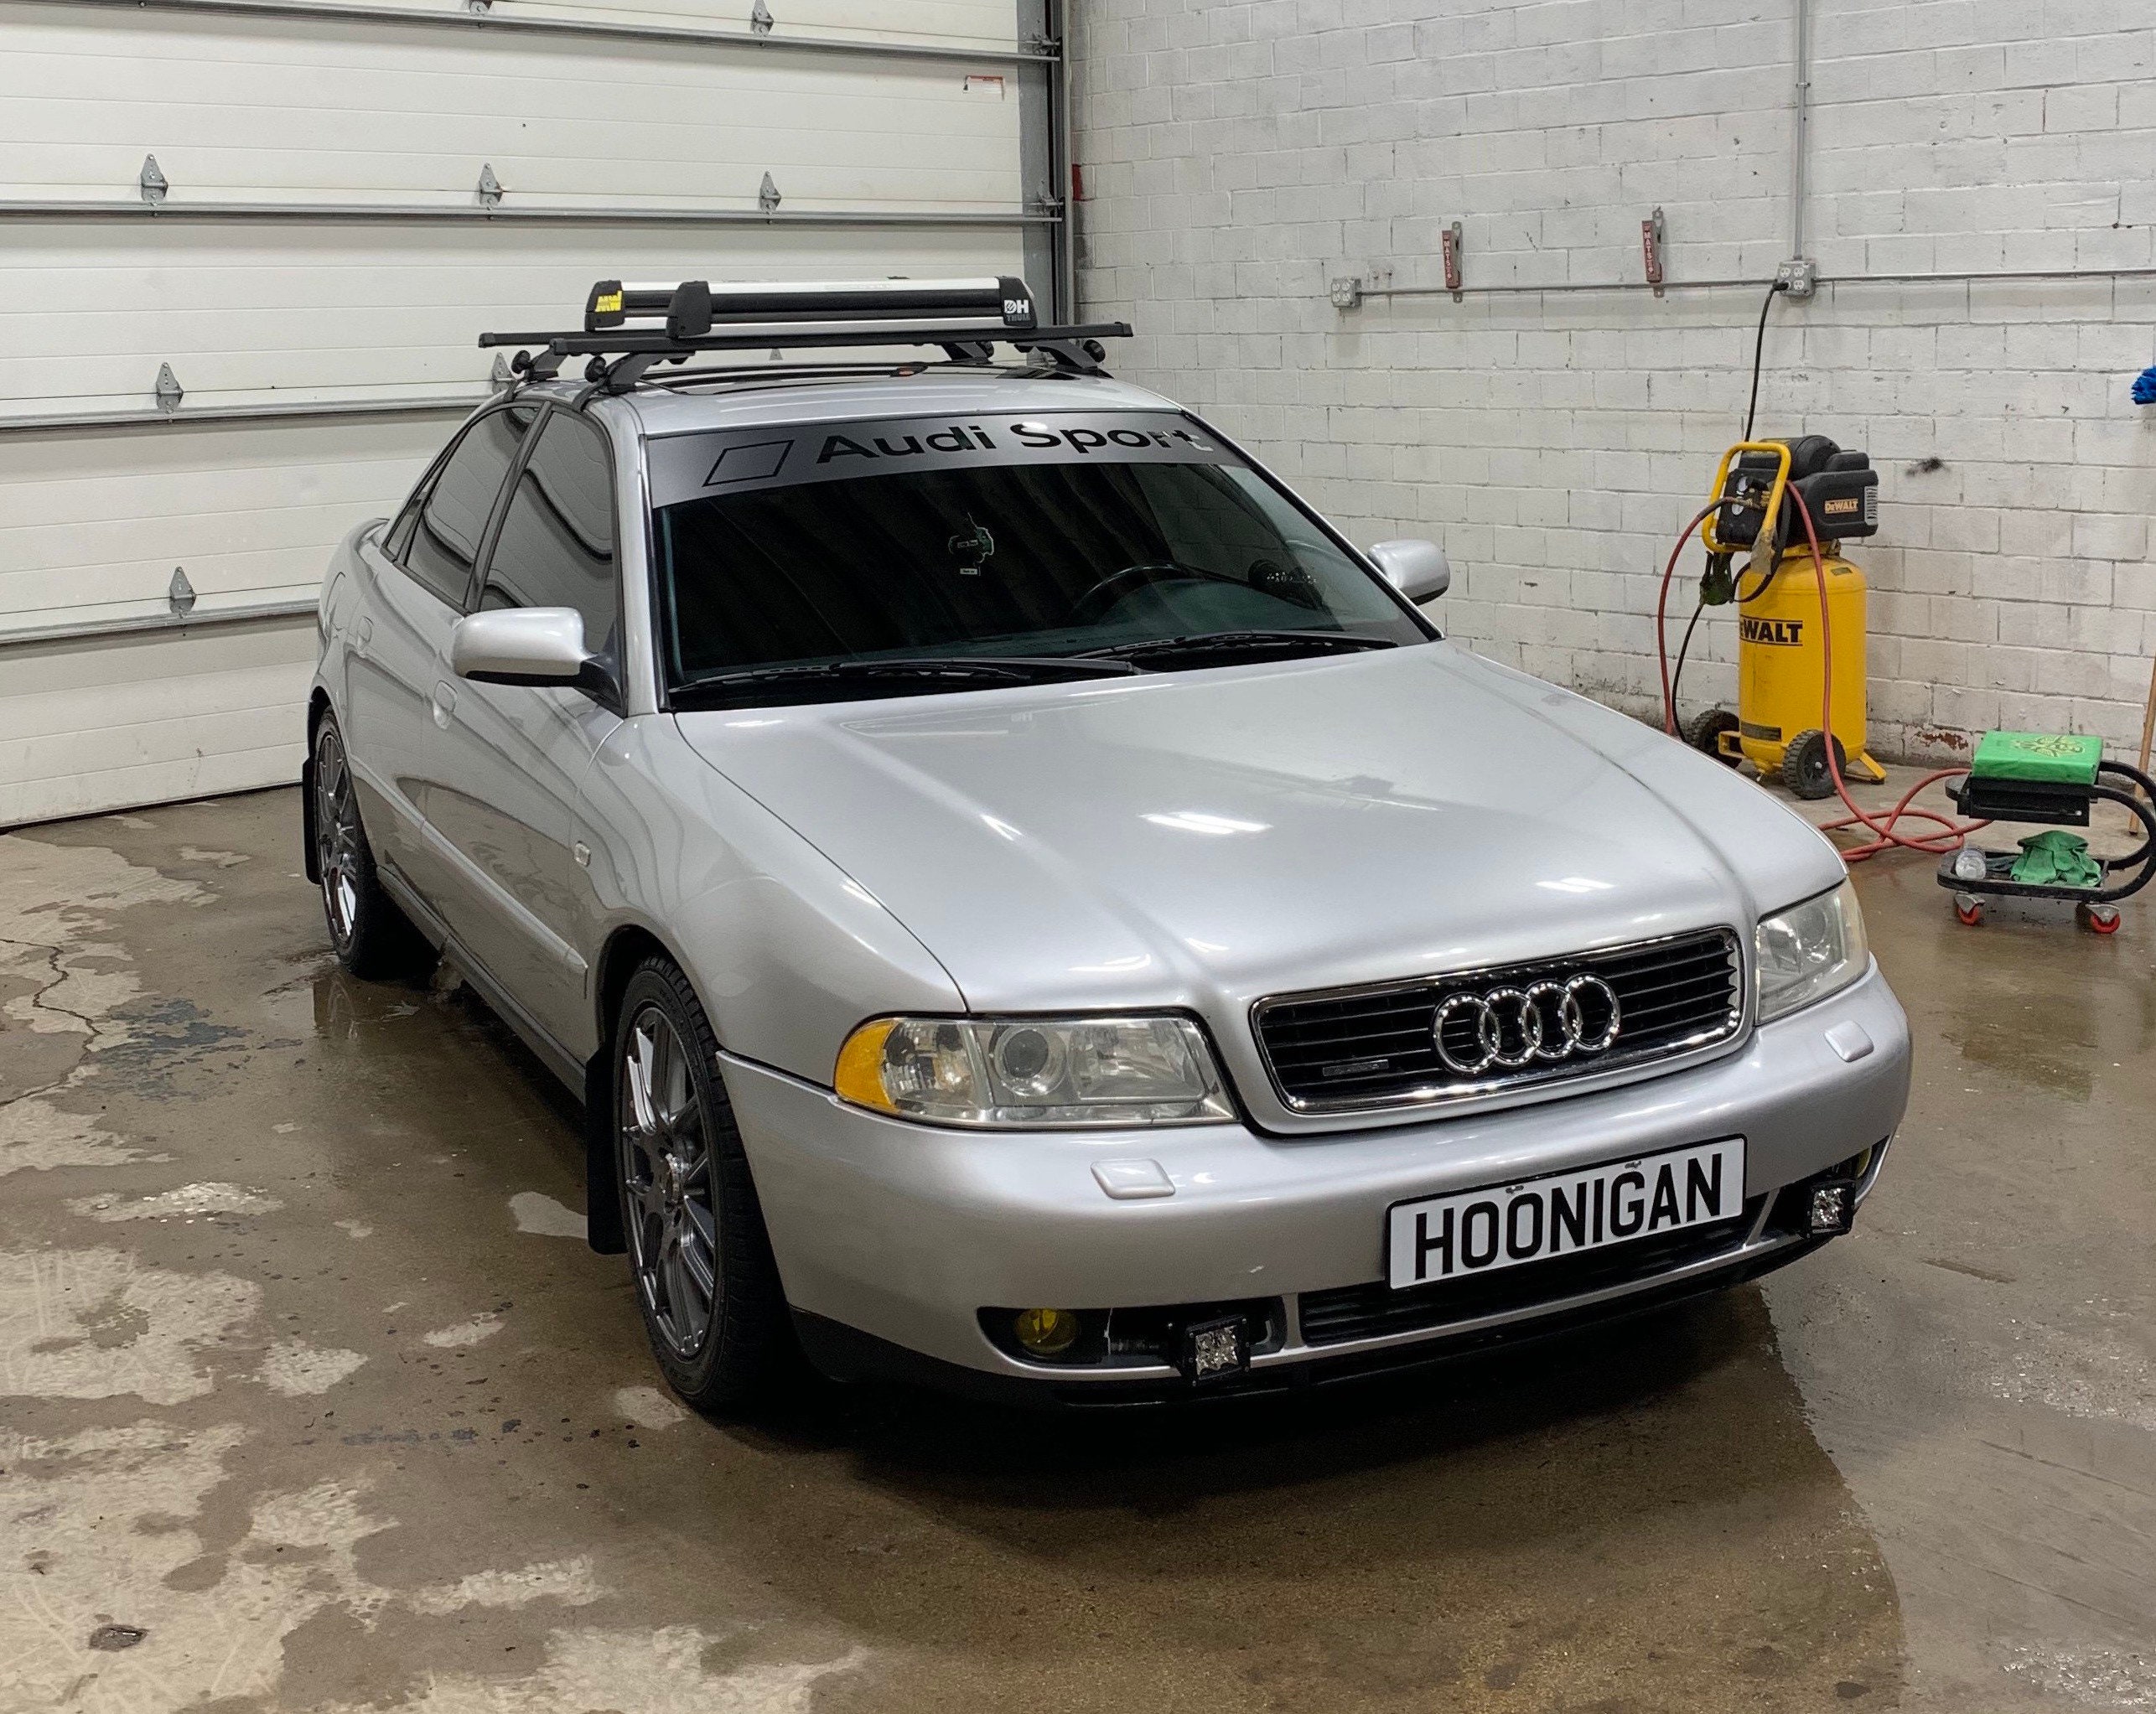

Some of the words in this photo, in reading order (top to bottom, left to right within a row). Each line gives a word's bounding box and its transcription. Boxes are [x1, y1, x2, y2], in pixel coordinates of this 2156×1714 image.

[816, 425, 996, 463] Audi
[1010, 422, 1215, 453] Sport
[1414, 1153, 1723, 1280] HOONIGAN
